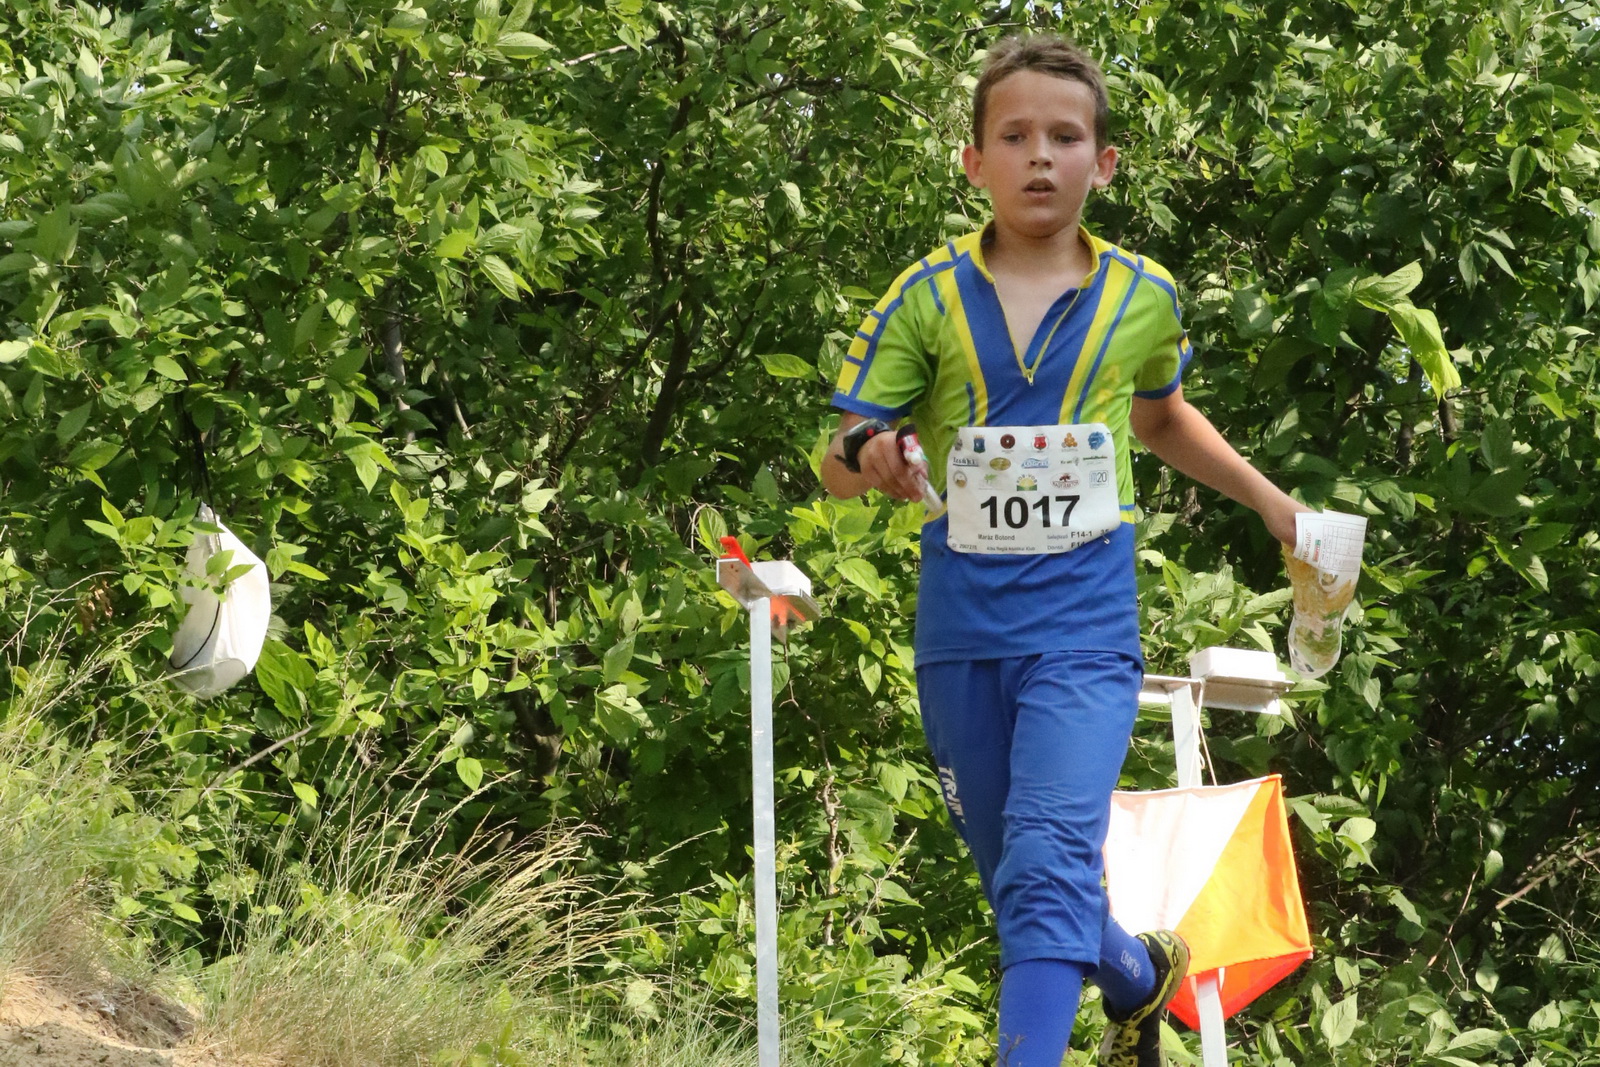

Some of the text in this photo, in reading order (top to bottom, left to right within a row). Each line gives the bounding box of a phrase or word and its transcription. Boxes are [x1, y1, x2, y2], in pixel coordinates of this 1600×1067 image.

[981, 494, 1080, 529] 1017
[994, 533, 1015, 541] Botond
[1070, 530, 1093, 538] F14-1
[938, 767, 966, 824] TRIM
